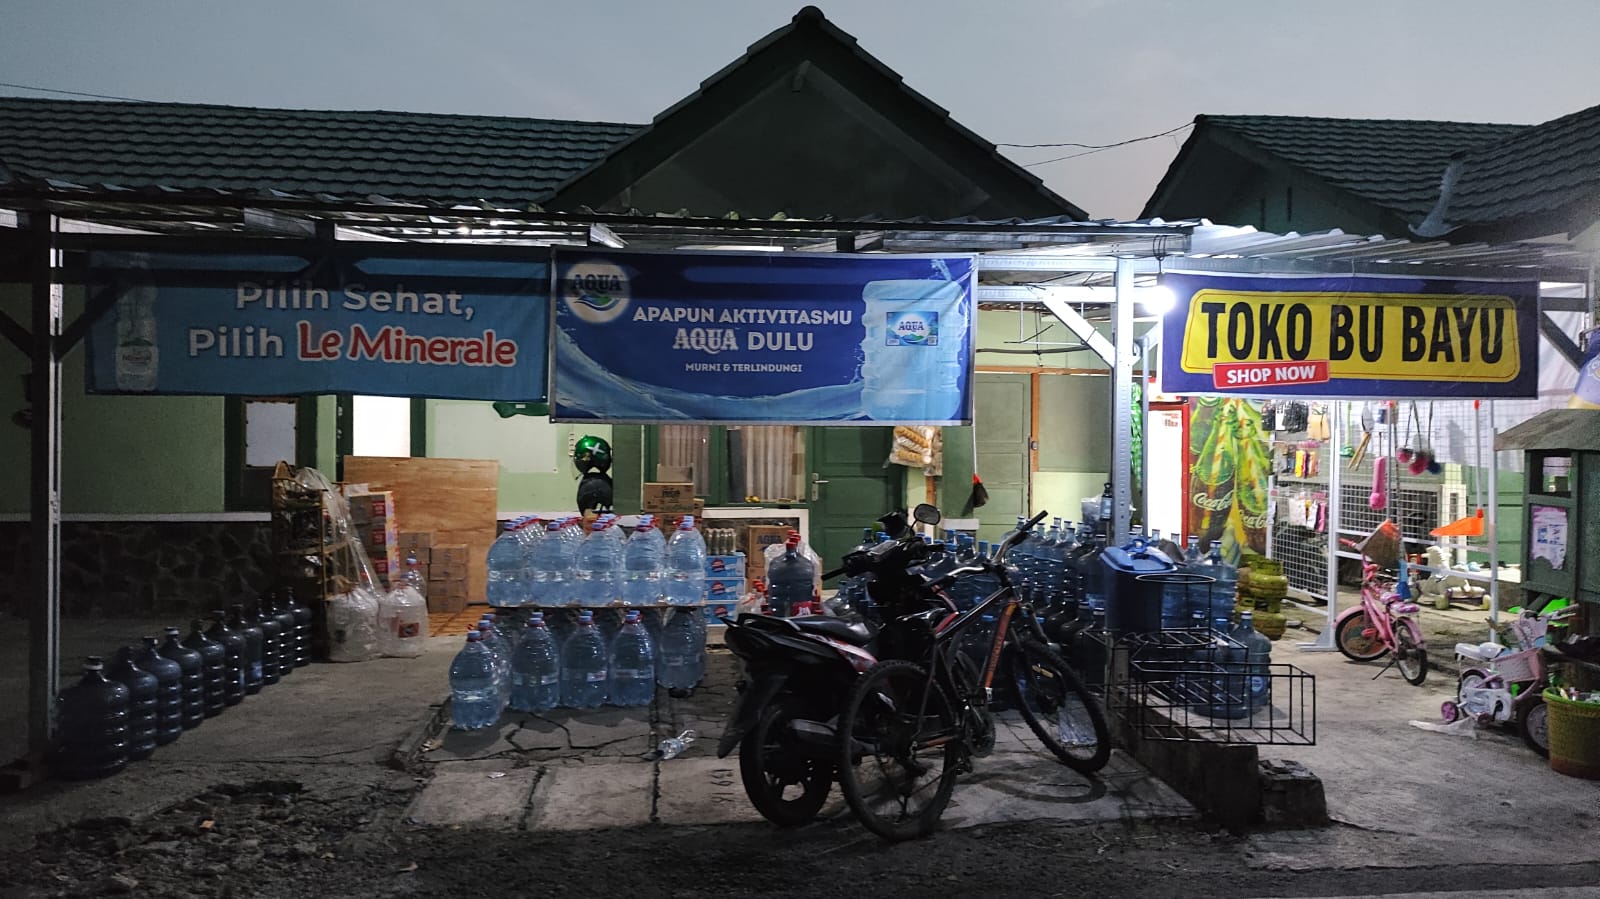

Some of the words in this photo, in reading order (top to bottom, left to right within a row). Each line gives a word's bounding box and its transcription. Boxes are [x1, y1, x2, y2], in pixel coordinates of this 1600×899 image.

[571, 273, 622, 295] AQUA
[236, 280, 330, 309] Pilih
[343, 282, 476, 321] Sehat,
[632, 306, 714, 323] APAPUN
[718, 308, 852, 326] AKTIVITASMU
[898, 321, 925, 332] AQUA
[188, 325, 284, 357] Pilih
[298, 321, 342, 361] Le
[348, 324, 518, 367] Minerale
[672, 328, 739, 354] AQUA
[747, 332, 813, 351] DULU
[1201, 302, 1312, 360] TOKO
[1329, 304, 1384, 362] BU
[1402, 305, 1504, 364] BAYU
[685, 363, 721, 373] MURNI
[723, 364, 731, 373] &
[732, 363, 803, 374] TERLINDUNGI
[1227, 367, 1272, 384] SHOP
[1275, 365, 1317, 382] NOW
